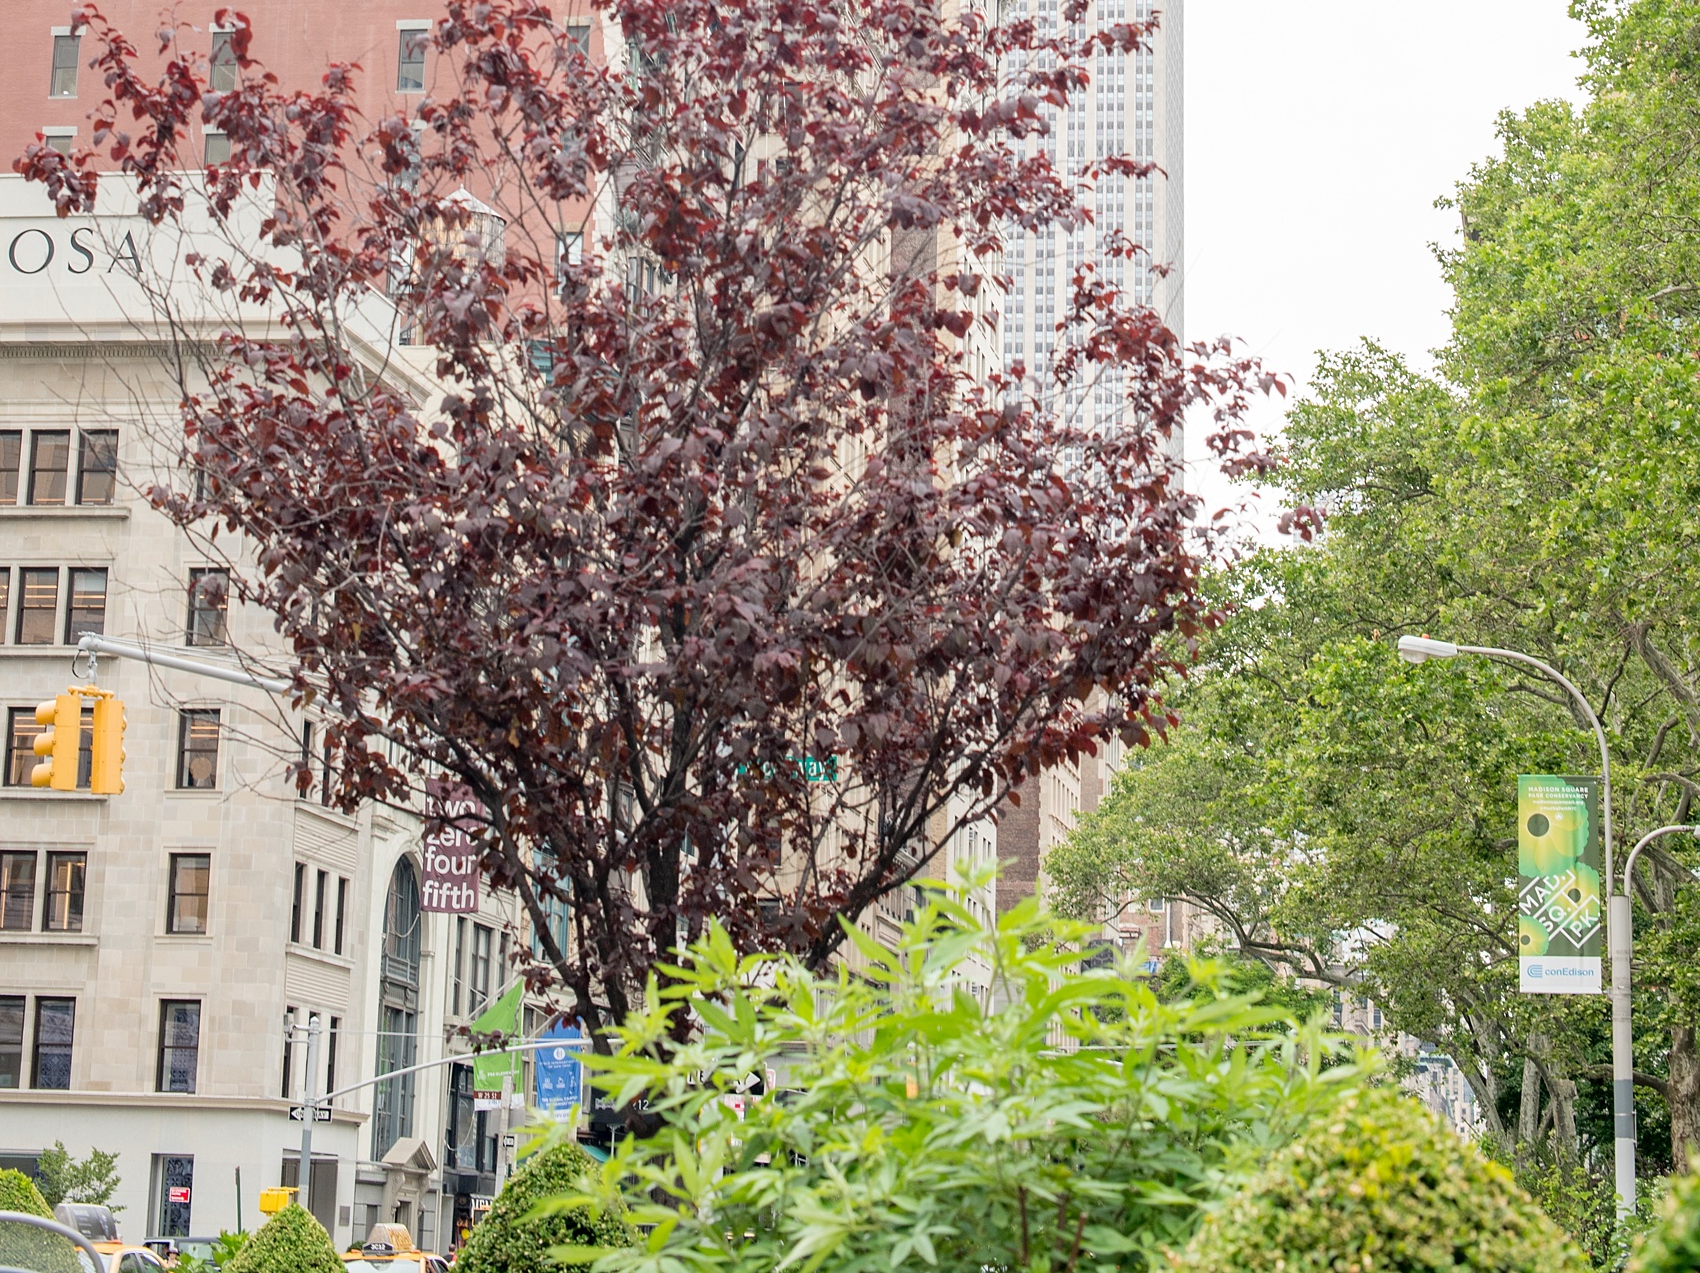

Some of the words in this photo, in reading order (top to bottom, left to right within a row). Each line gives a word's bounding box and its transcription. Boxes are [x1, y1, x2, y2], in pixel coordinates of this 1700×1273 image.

[8, 227, 144, 275] OSA
[425, 845, 477, 875] four
[422, 879, 475, 910] fifth
[1545, 966, 1595, 978] conEdison
